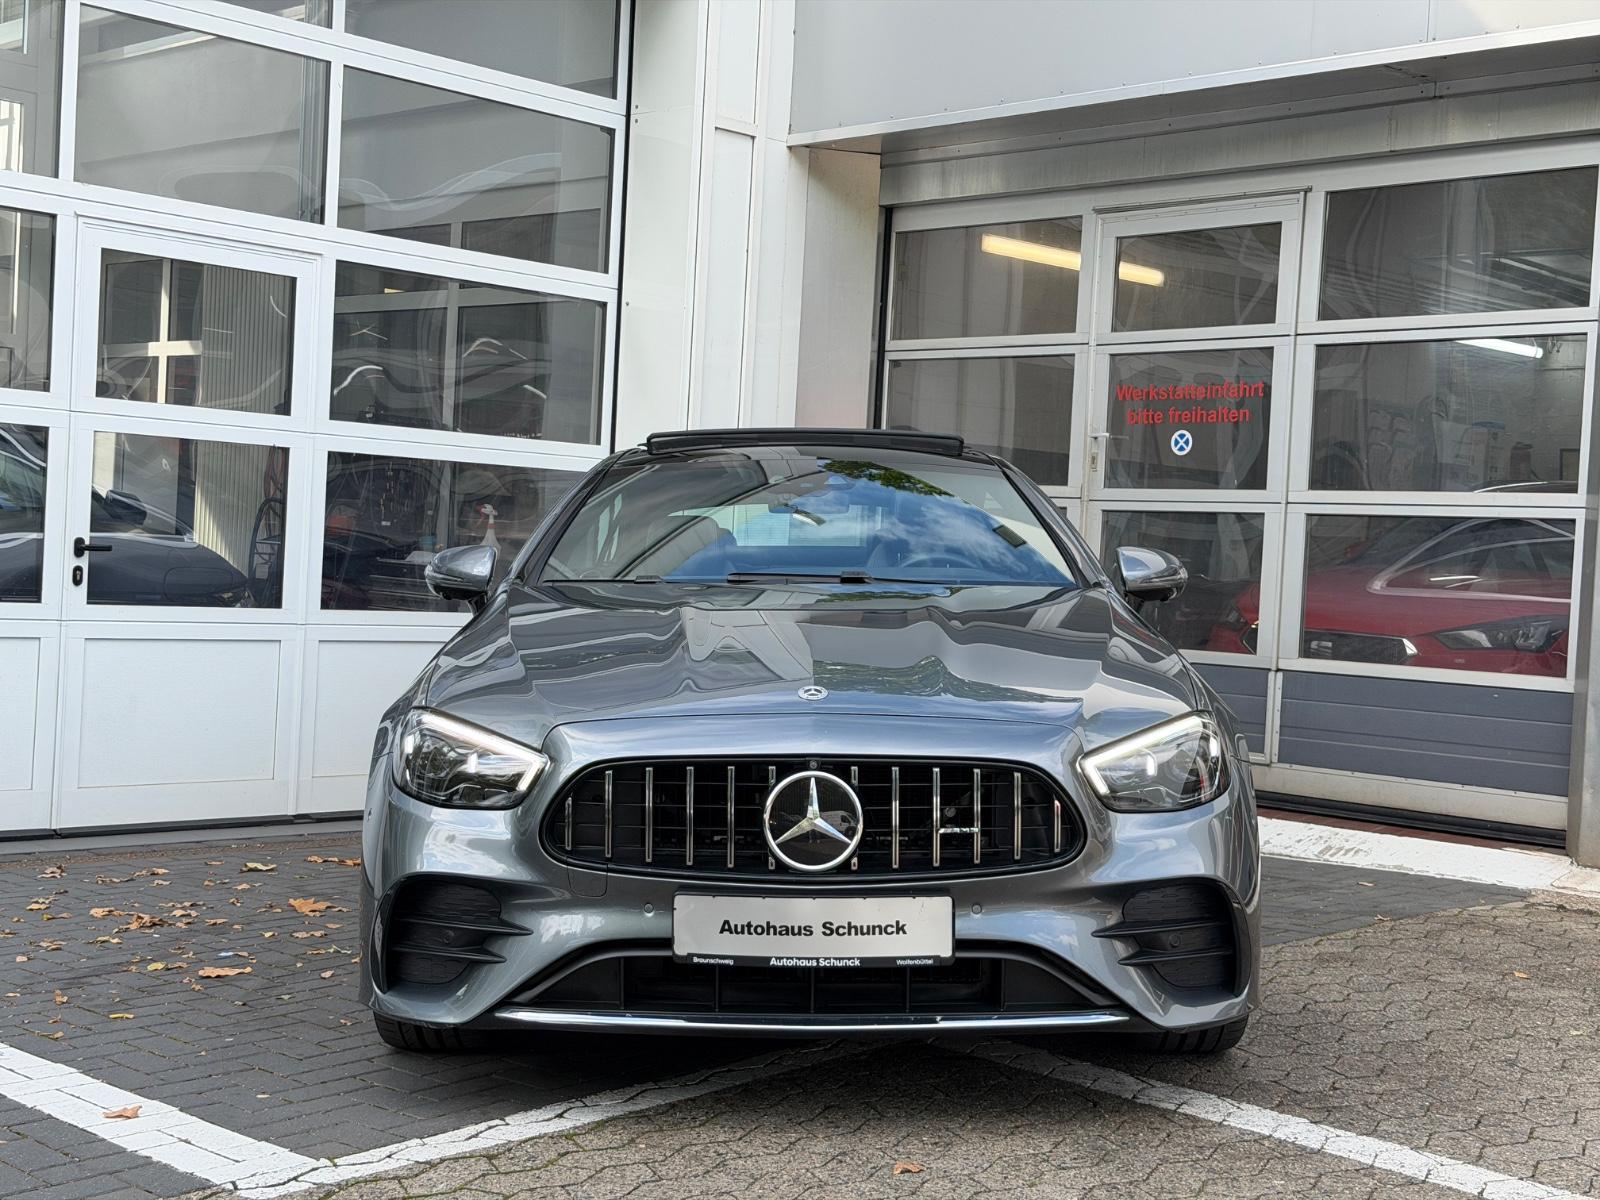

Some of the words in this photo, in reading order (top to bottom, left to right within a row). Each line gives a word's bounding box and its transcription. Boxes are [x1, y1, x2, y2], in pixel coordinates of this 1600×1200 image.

[1117, 380, 1265, 401] Werkstatteinfahrt
[1127, 408, 1163, 425] bitte
[1168, 406, 1249, 424] freihalten
[719, 919, 814, 937] Autohaus
[821, 919, 908, 937] Schunck
[769, 957, 817, 967] Autohaus
[818, 957, 861, 967] Schunck
